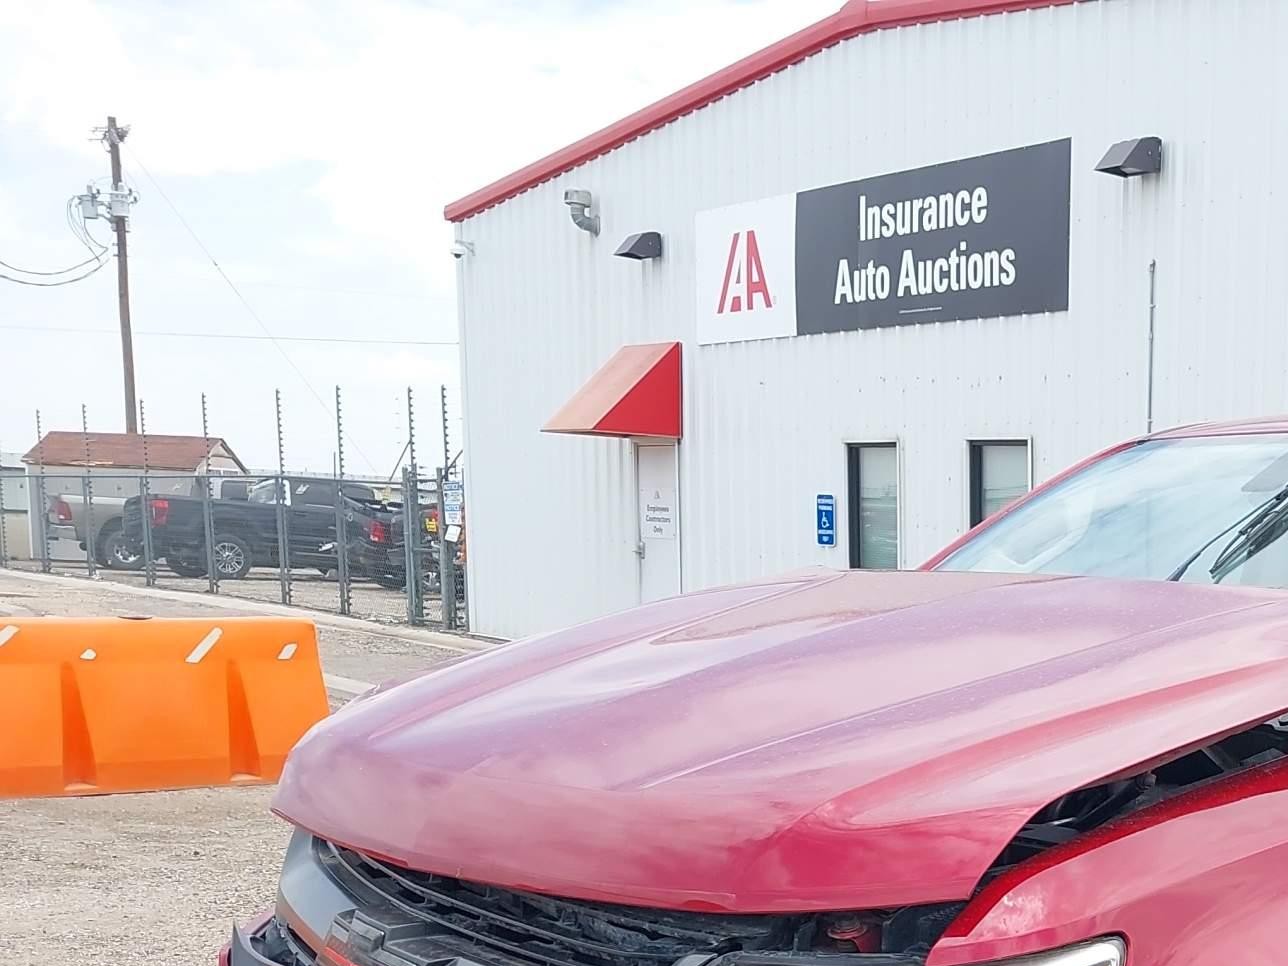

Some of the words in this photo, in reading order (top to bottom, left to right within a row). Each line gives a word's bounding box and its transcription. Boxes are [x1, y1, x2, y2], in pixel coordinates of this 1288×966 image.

[858, 186, 988, 241] Insurance
[833, 259, 890, 305] Auto
[897, 241, 1016, 298] Auctions
